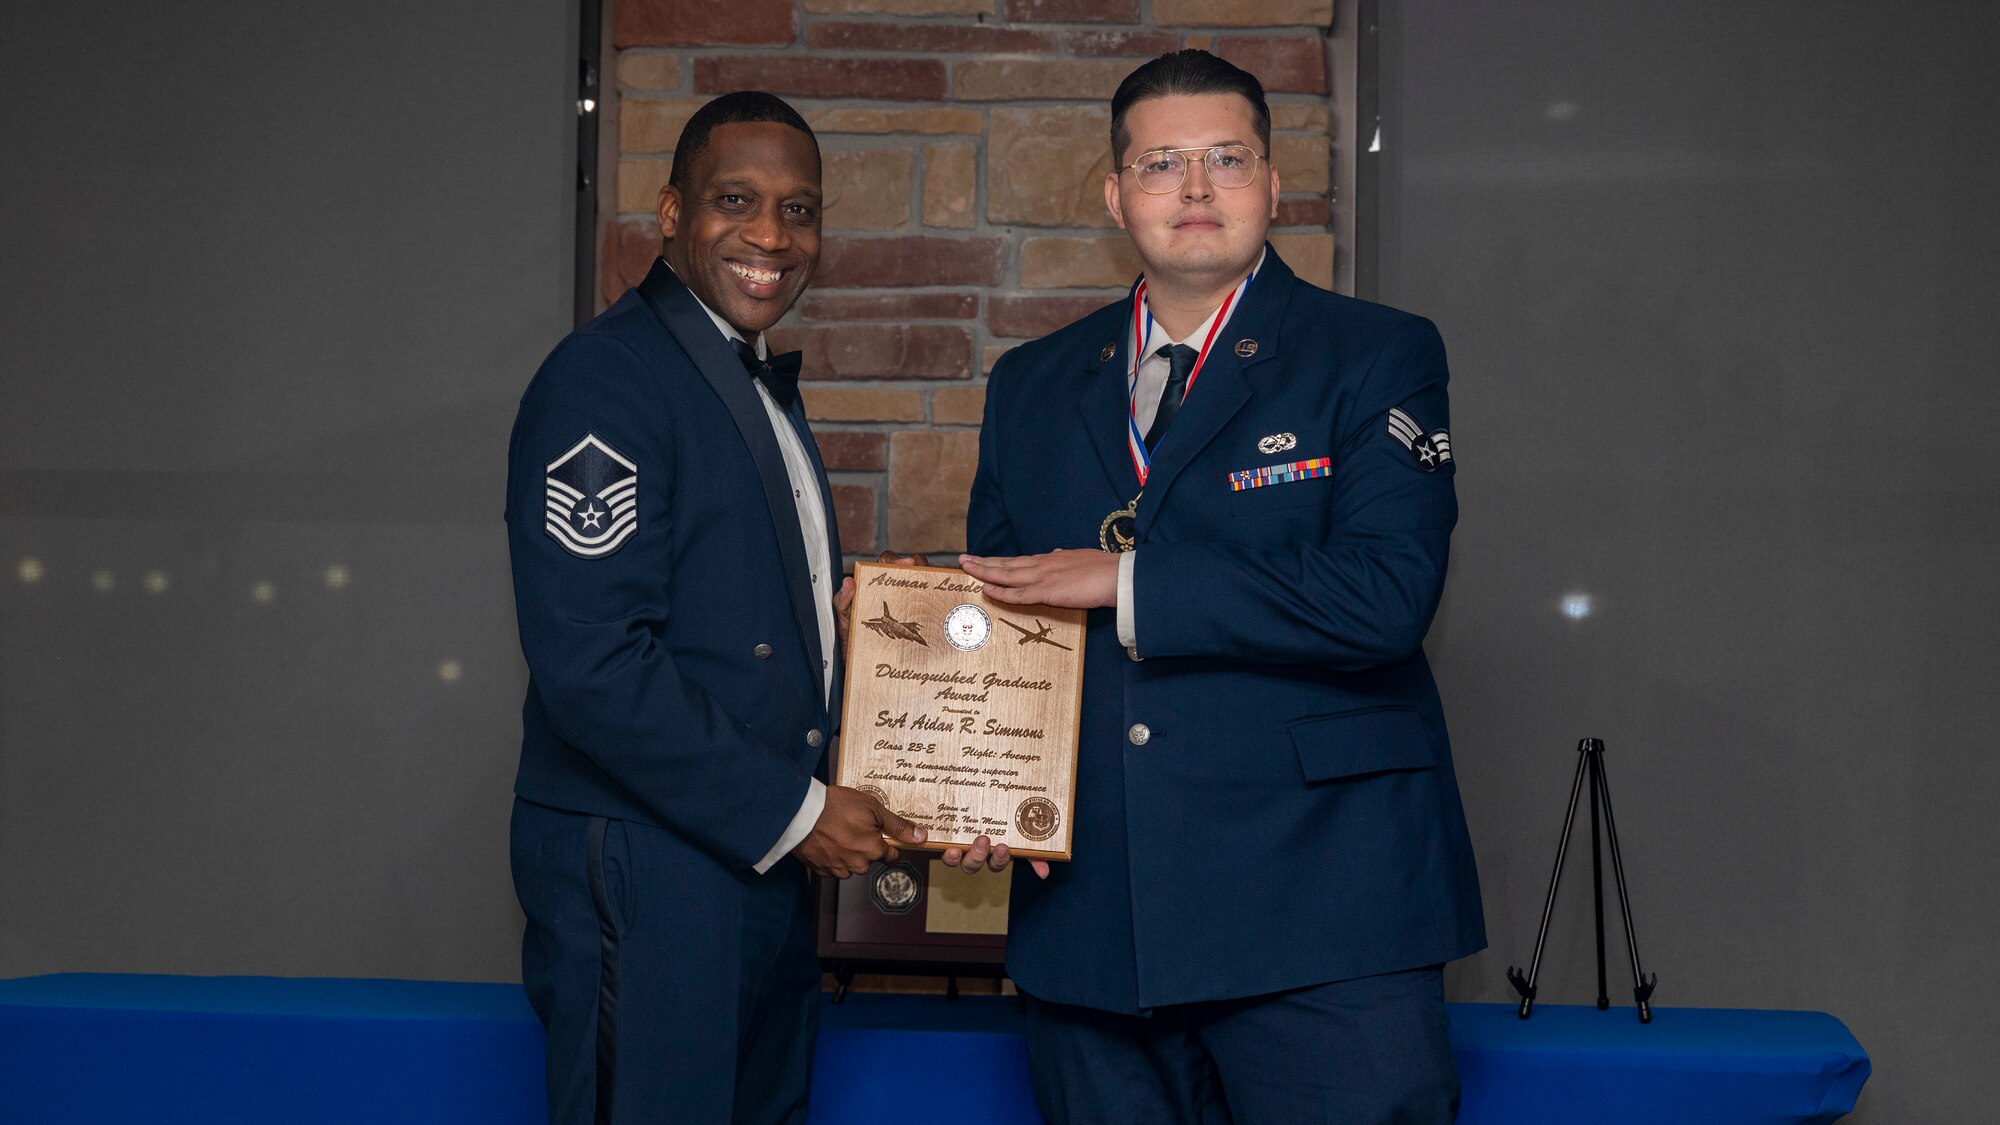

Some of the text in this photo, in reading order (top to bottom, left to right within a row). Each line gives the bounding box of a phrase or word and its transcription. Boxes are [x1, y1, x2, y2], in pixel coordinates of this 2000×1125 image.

[868, 572, 929, 589] Airman
[875, 663, 1053, 691] Distinguished Graduate
[934, 686, 989, 703] Award
[941, 705, 981, 716] Presented to
[874, 709, 1045, 739] SrA Aidan R. Simmons
[873, 739, 1042, 763] Class 23-E Flight: Avenger
[895, 758, 1020, 777] For demonstrating superior
[863, 769, 1048, 793] Leadership and Academic Performance
[937, 803, 959, 812] Given
[897, 810, 1009, 826] Holloman AFB, New Mexico
[935, 825, 951, 833] day
[952, 827, 962, 835] of
[962, 826, 982, 835] May
[984, 827, 1007, 836] 2023
